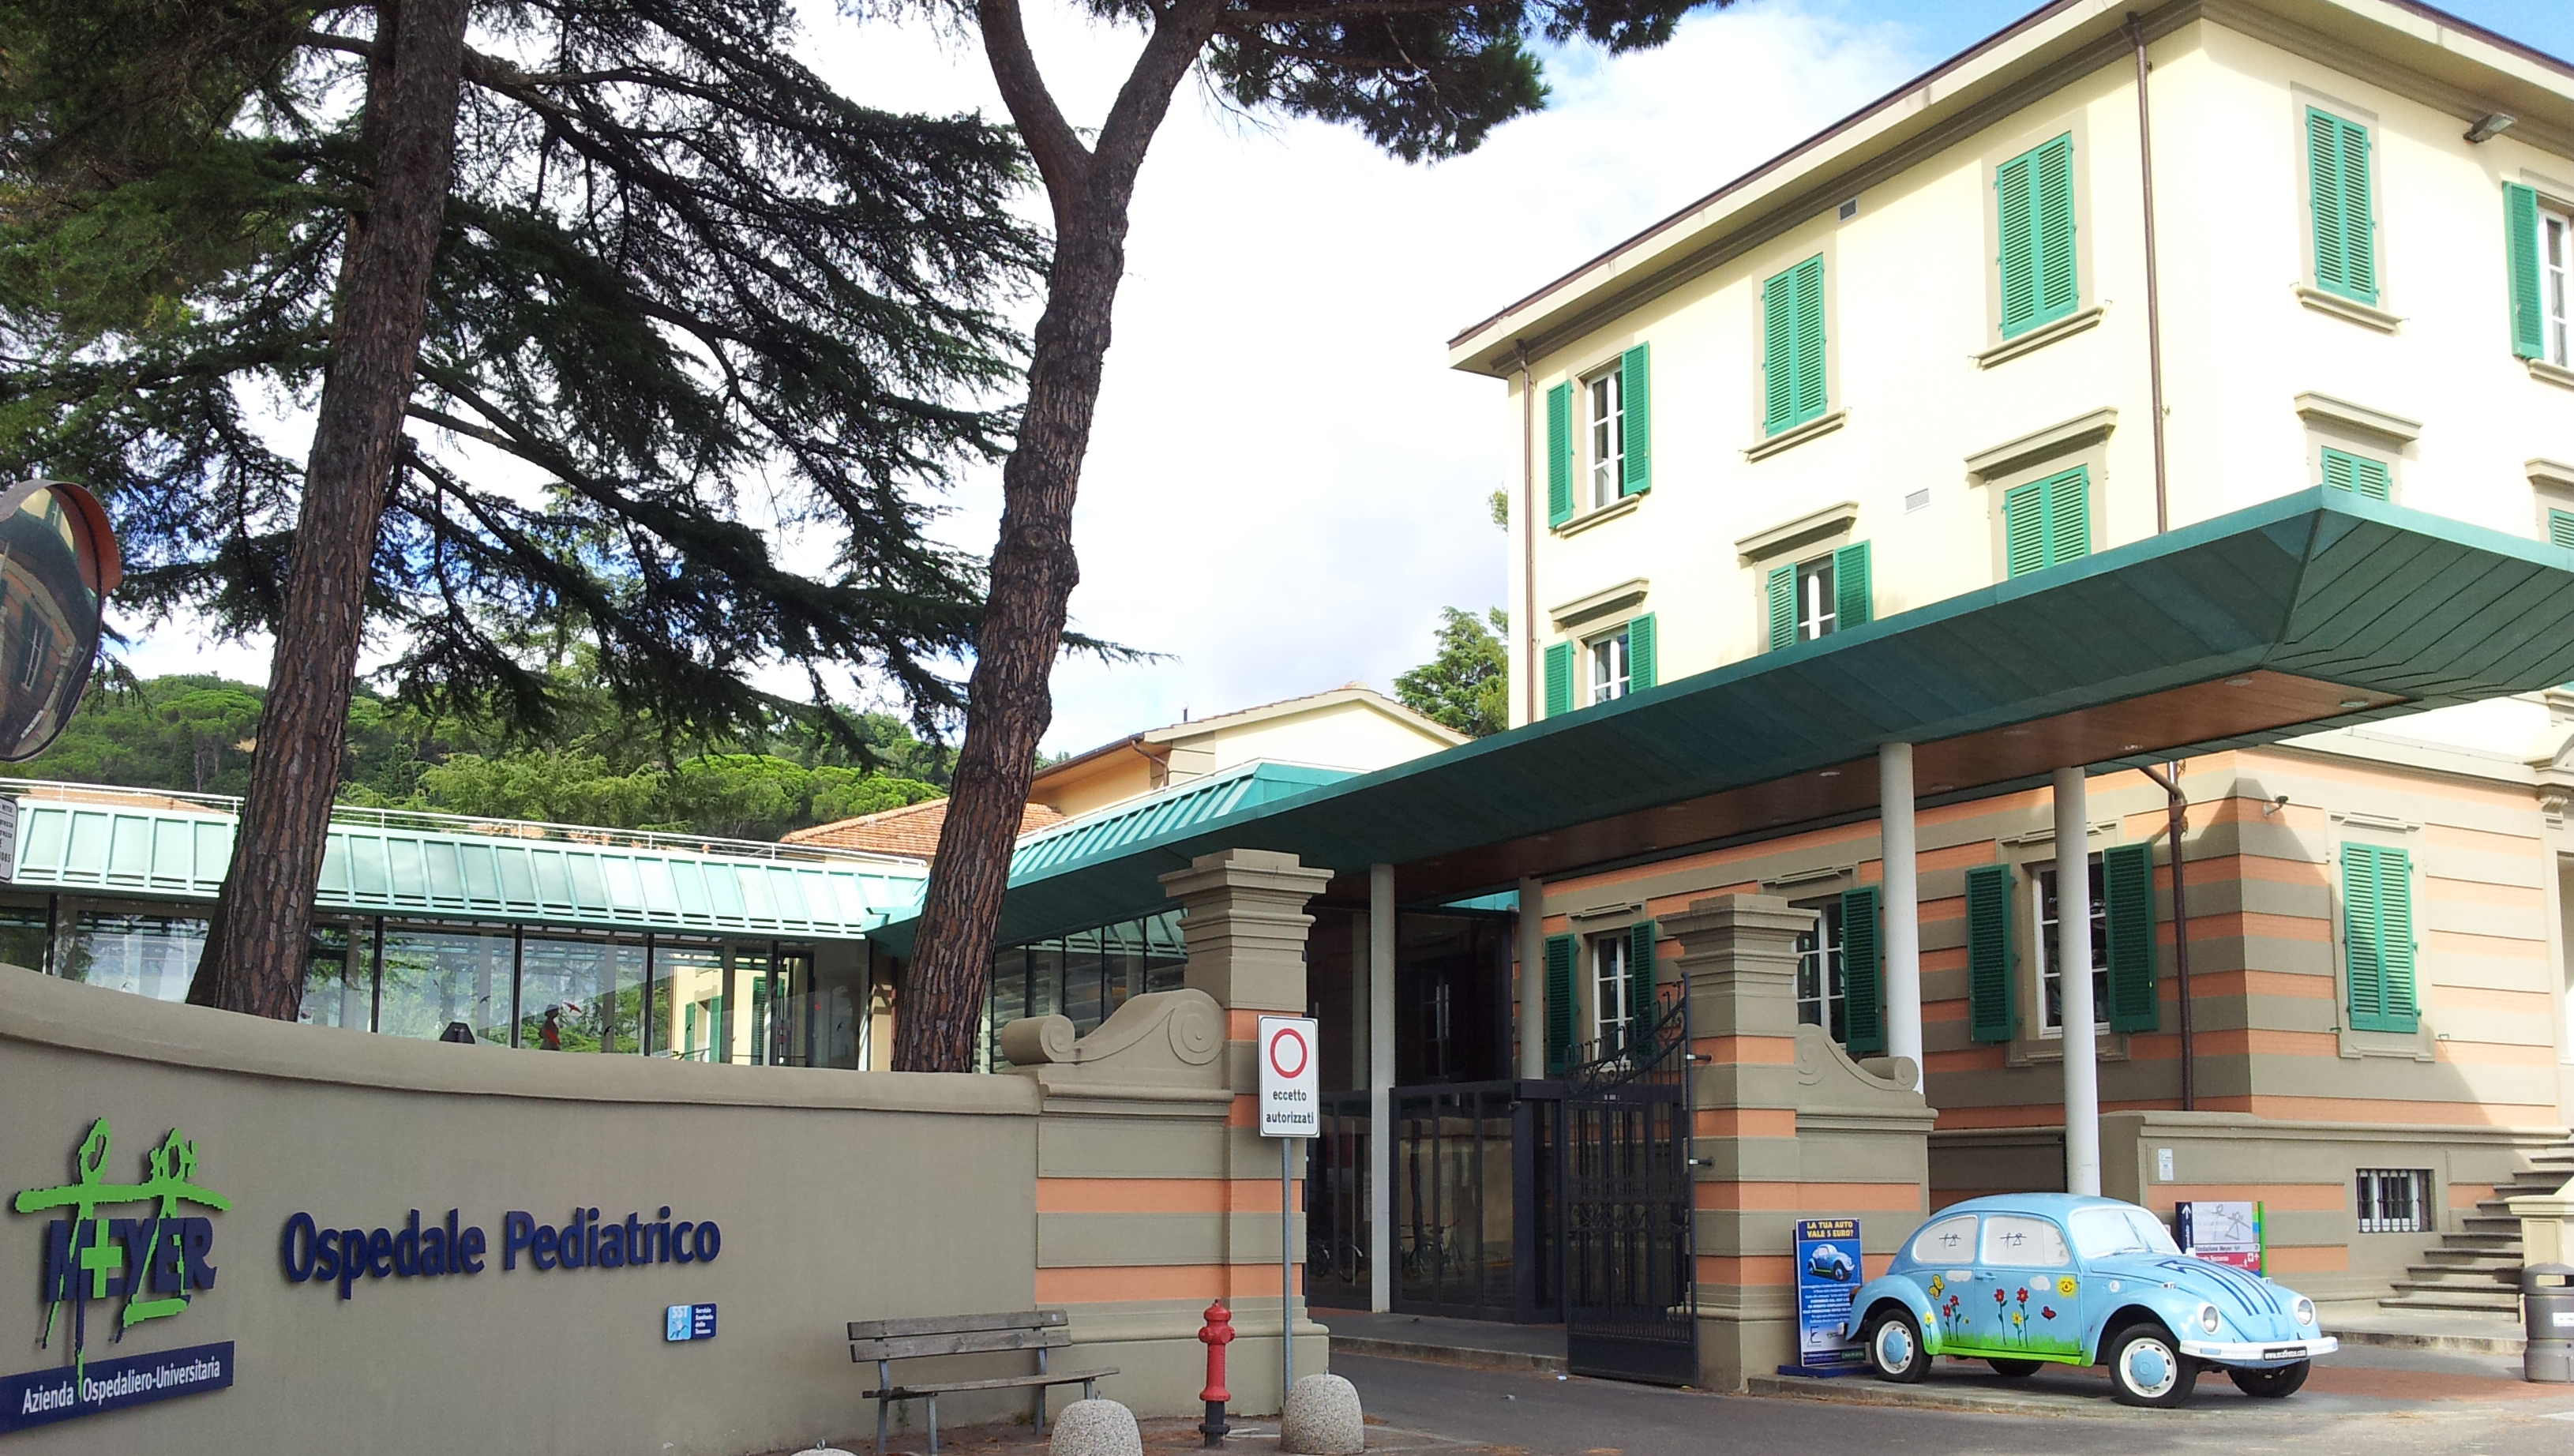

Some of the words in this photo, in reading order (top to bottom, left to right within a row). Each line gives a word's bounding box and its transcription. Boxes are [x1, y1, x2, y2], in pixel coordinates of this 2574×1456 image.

[1273, 1089, 1307, 1101] eccetto
[1266, 1111, 1315, 1124] autorizzati
[46, 1217, 217, 1302] MEYER
[283, 1207, 486, 1300] Ospedale
[504, 1205, 722, 1270] Pediatrico
[672, 1306, 689, 1319] SST
[22, 1385, 74, 1414] Azienda
[82, 1356, 221, 1406] Ospedaliero-Universitaria
